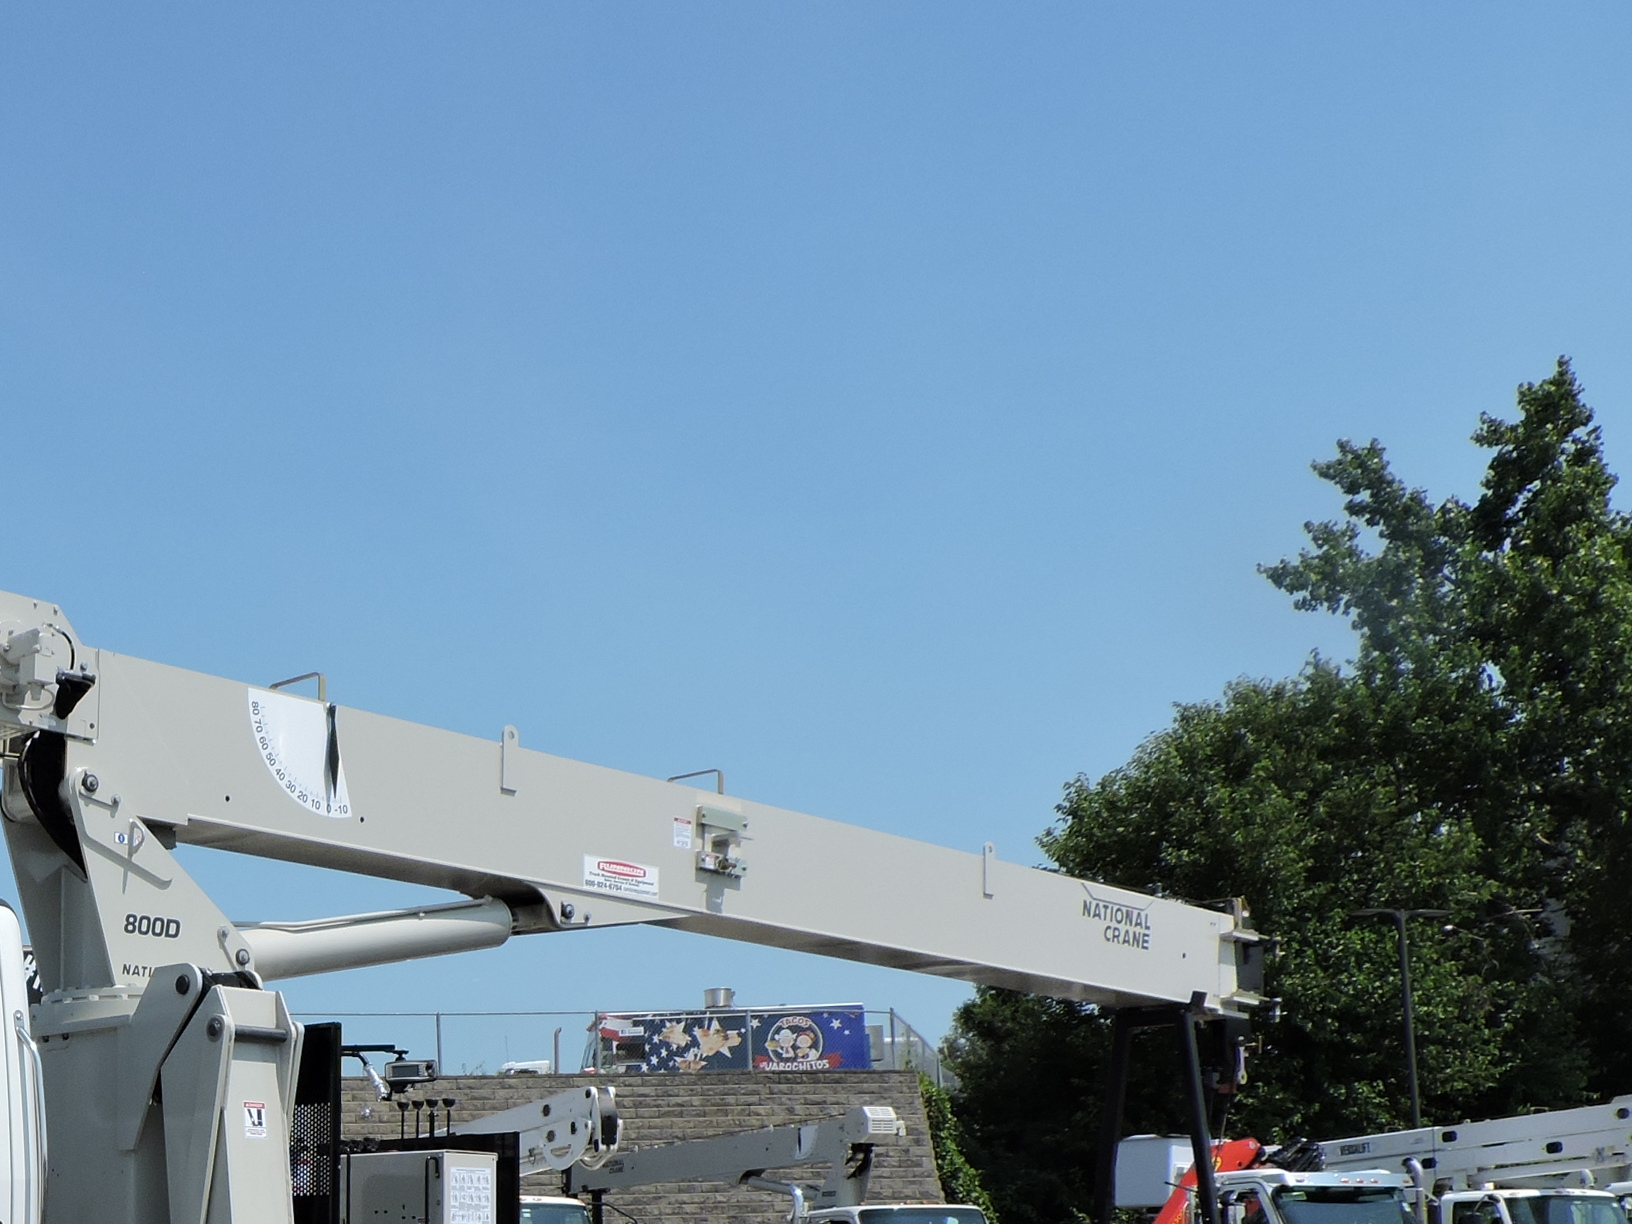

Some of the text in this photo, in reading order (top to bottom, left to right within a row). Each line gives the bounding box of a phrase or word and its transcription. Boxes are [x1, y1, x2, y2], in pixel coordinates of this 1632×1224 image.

[251, 701, 260, 716] 80
[254, 718, 263, 733] 70
[259, 736, 269, 751] 60
[265, 752, 276, 767] 50
[275, 768, 286, 781] 40
[285, 780, 297, 794] 30
[296, 790, 309, 804] 20
[310, 798, 321, 810] 10
[326, 803, 332, 814] 0
[334, 804, 348, 814] -10
[1082, 899, 1151, 930] NATIONAL
[123, 913, 181, 939] 800D
[1104, 925, 1150, 950] CRANE
[122, 963, 153, 978] NATI
